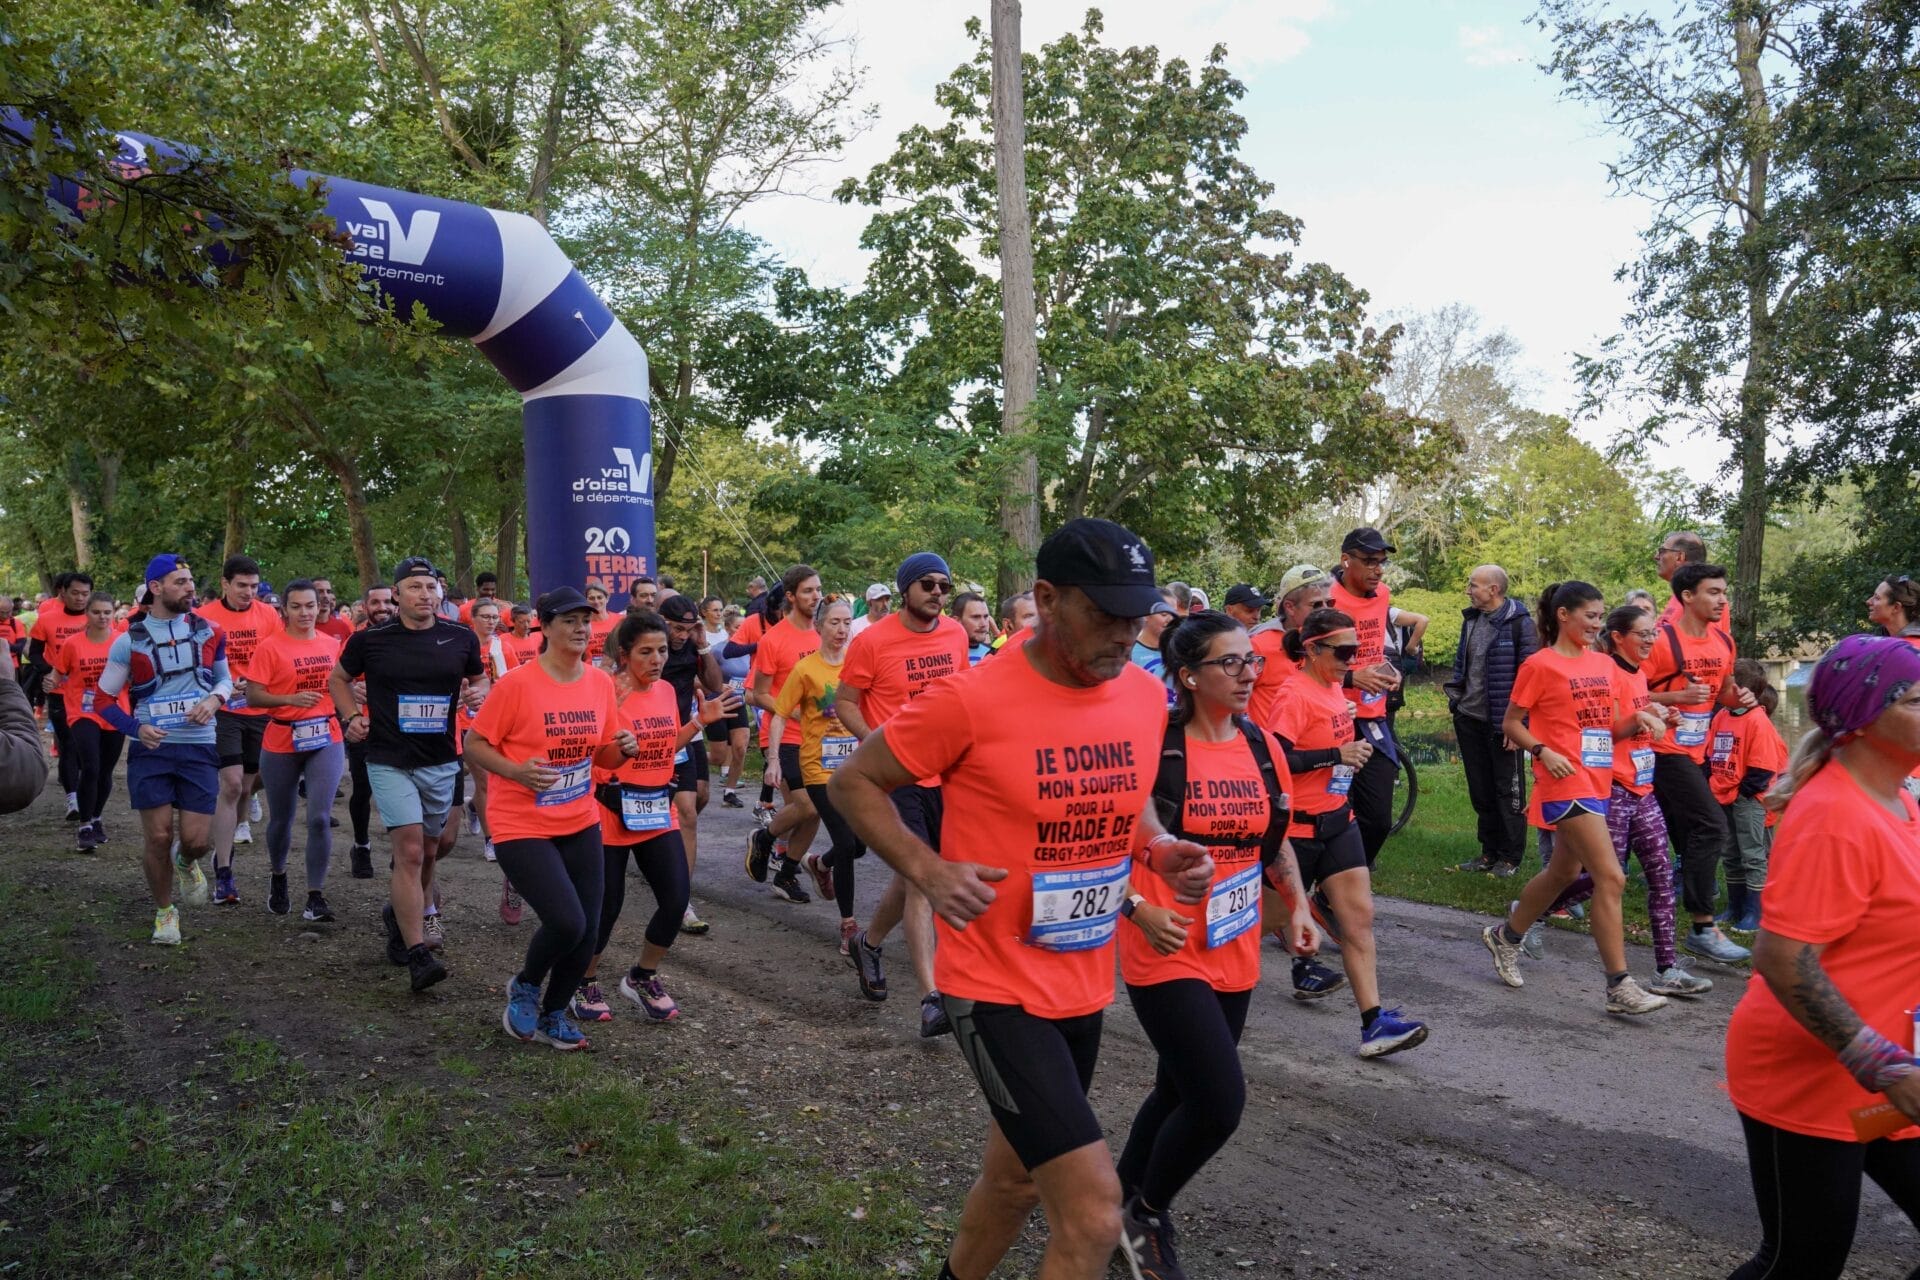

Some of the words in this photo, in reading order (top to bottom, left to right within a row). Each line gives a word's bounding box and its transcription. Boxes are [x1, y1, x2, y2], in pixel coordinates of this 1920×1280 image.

[346, 221, 385, 240] val
[601, 466, 628, 479] val
[572, 477, 628, 491] d'oise
[572, 493, 584, 503] le
[585, 555, 647, 575] TERRE
[1359, 618, 1380, 631] DONNE
[229, 630, 257, 639] DONNE
[293, 658, 303, 667] JE
[304, 655, 332, 667] DONNE
[905, 658, 916, 671] JE
[918, 653, 953, 669] DONNE
[1694, 657, 1722, 669] DONNE
[908, 671, 925, 682] MON
[1569, 679, 1580, 690] JE
[1572, 691, 1587, 700] MON
[168, 701, 186, 714] 174
[419, 704, 435, 718] 117
[1601, 706, 1611, 718] DE
[543, 712, 557, 726] JE
[558, 710, 597, 724] DONNE
[632, 719, 643, 730] JE
[644, 715, 675, 729] DONNE
[1331, 715, 1340, 729] JE
[309, 725, 320, 736] 74
[545, 727, 567, 738] MON
[568, 725, 598, 736] SOUFFLE
[560, 737, 579, 746] POUR
[579, 737, 587, 745] LA
[646, 741, 660, 749] POUR
[660, 740, 668, 748] LA
[547, 746, 584, 761] VIRADE
[634, 748, 665, 761] VIRADE
[838, 744, 853, 756] 214
[1036, 748, 1058, 775] JE
[1064, 741, 1135, 773] DONNE
[562, 772, 575, 788] 77
[1038, 780, 1075, 800] MON
[1080, 773, 1138, 796] SOUFFLE
[1186, 781, 1203, 800] JE
[1207, 780, 1261, 799] DONNE
[634, 800, 654, 815] 319
[1065, 801, 1098, 817] POUR
[1102, 800, 1115, 813] LA
[1188, 803, 1217, 817] MON
[1220, 801, 1265, 816] SOUFFLE
[1037, 817, 1108, 843] VIRADE
[1112, 814, 1136, 837] DE
[1210, 820, 1236, 831] POUR
[1238, 820, 1249, 830] LA
[1034, 838, 1129, 861] CERGY-PONTOISE
[1069, 885, 1110, 920] 282
[1229, 887, 1249, 914] 231
